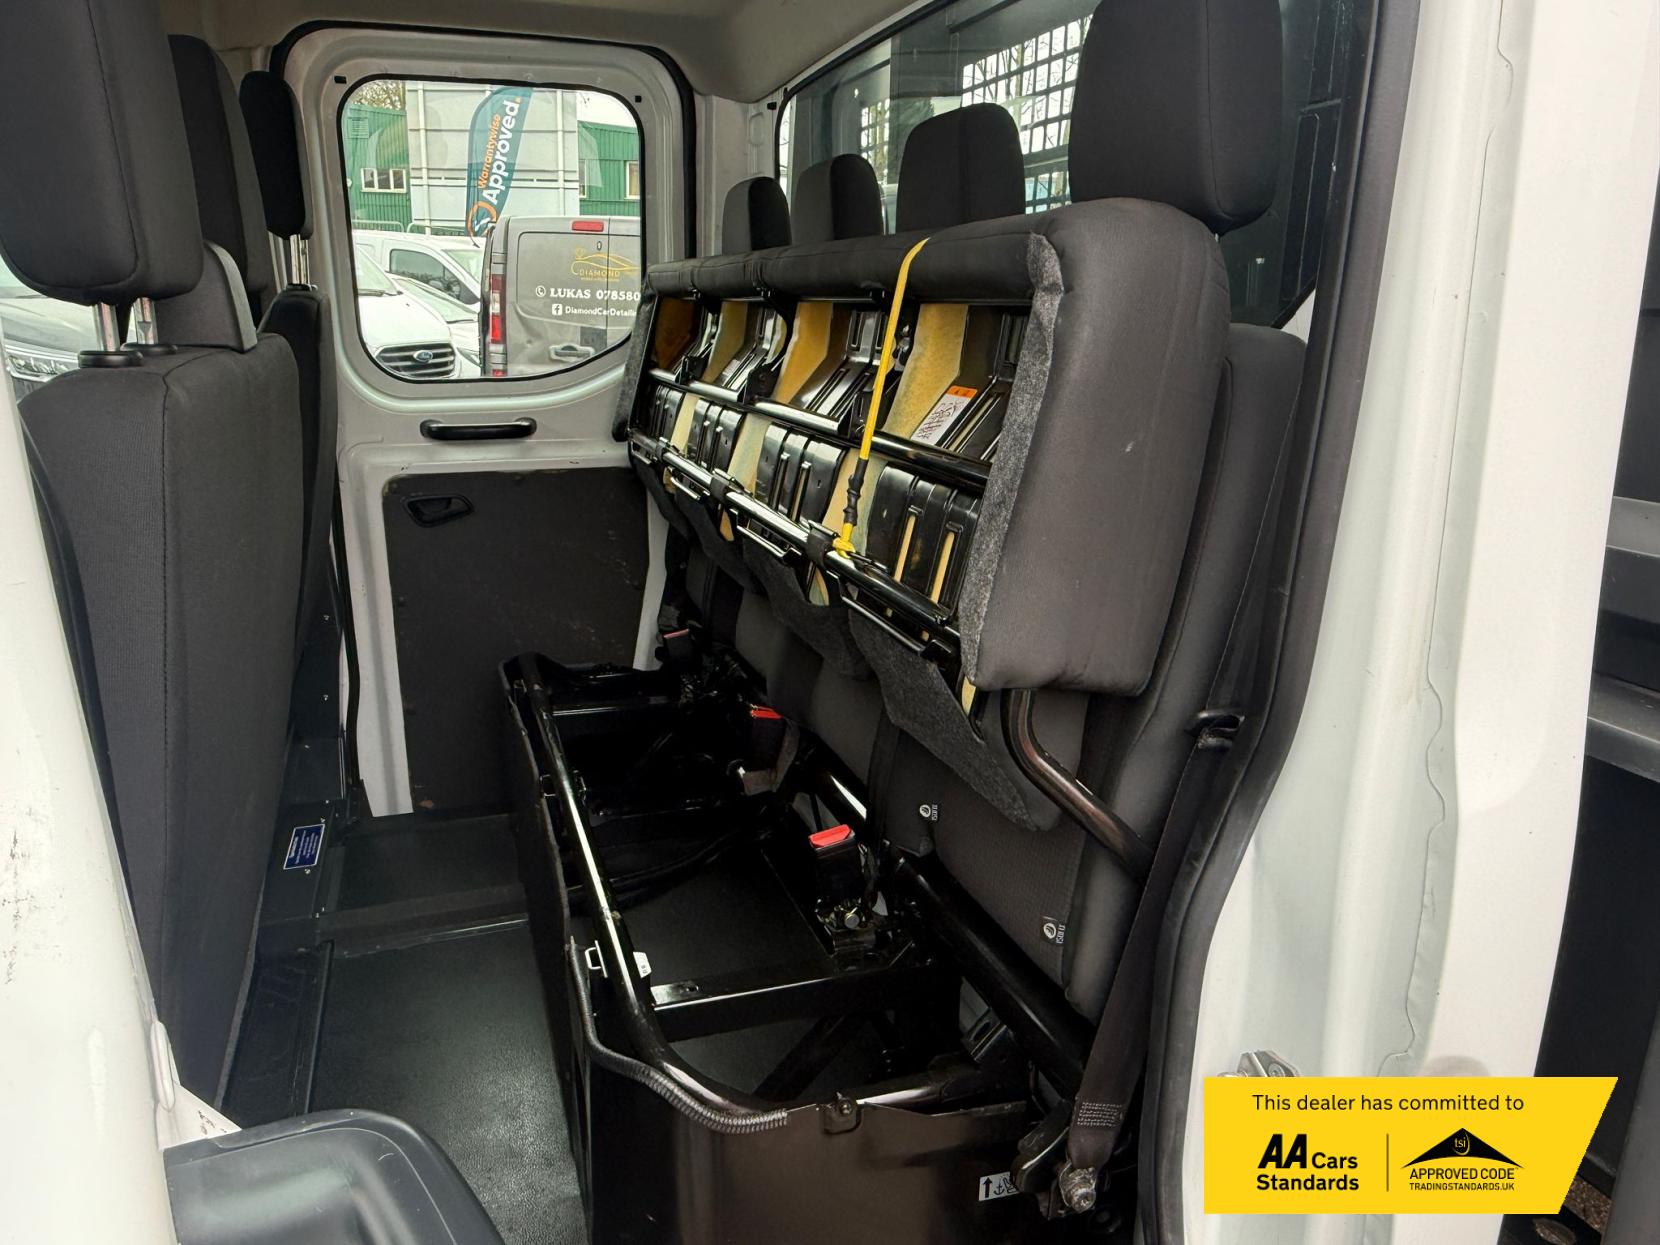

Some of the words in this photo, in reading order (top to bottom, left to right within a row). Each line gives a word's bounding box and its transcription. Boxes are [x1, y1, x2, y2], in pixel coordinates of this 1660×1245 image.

[478, 113, 501, 189] Warrantywise
[579, 269, 621, 278] DIAMOND
[550, 287, 591, 299] LUKAS
[596, 290, 641, 301] 078580
